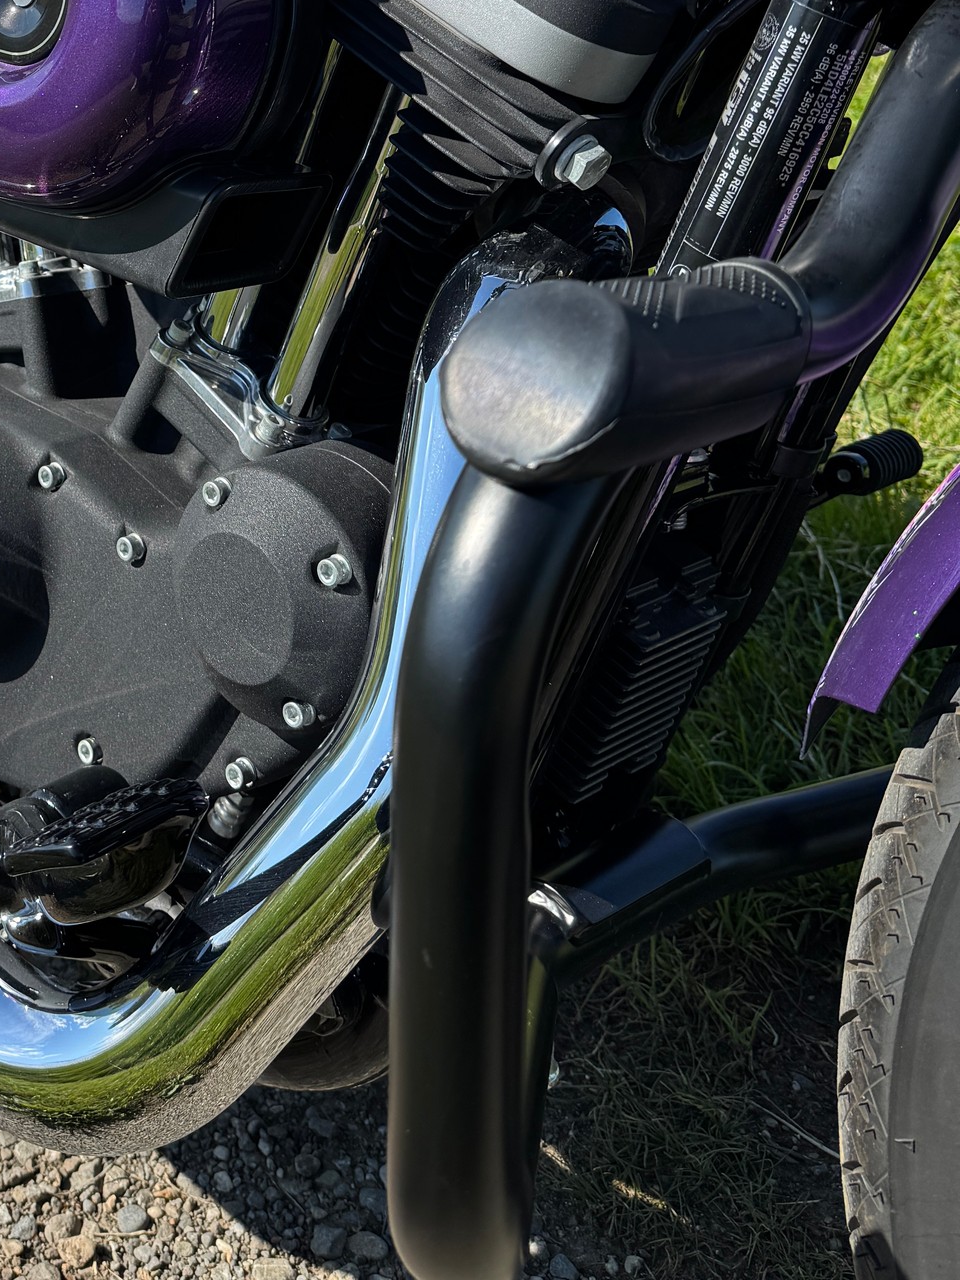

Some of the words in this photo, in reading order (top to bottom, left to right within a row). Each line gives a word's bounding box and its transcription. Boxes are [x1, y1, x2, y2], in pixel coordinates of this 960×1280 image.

[785, 24, 797, 39] 35
[798, 30, 811, 45] 25
[777, 37, 791, 56] kW
[790, 44, 805, 63] kW
[826, 42, 839, 55] 96
[756, 55, 783, 101] VARIANT
[810, 56, 831, 84] dB(A)
[769, 62, 797, 108] VARIANT
[816, 50, 867, 146] HARLEY-DAVIDSON
[749, 99, 762, 113] 94
[762, 106, 775, 121] 95
[797, 90, 815, 114] 2950
[735, 112, 754, 141] dB(A)
[747, 119, 768, 148] dB(A)
[776, 114, 804, 157] REV/MIN
[723, 145, 739, 171] 2875
[735, 153, 752, 177] 3000
[798, 146, 821, 184] MOTOR
[704, 169, 729, 211] REV/MIN
[715, 176, 742, 218] REV/MIN
[775, 184, 803, 234] COMPANY
